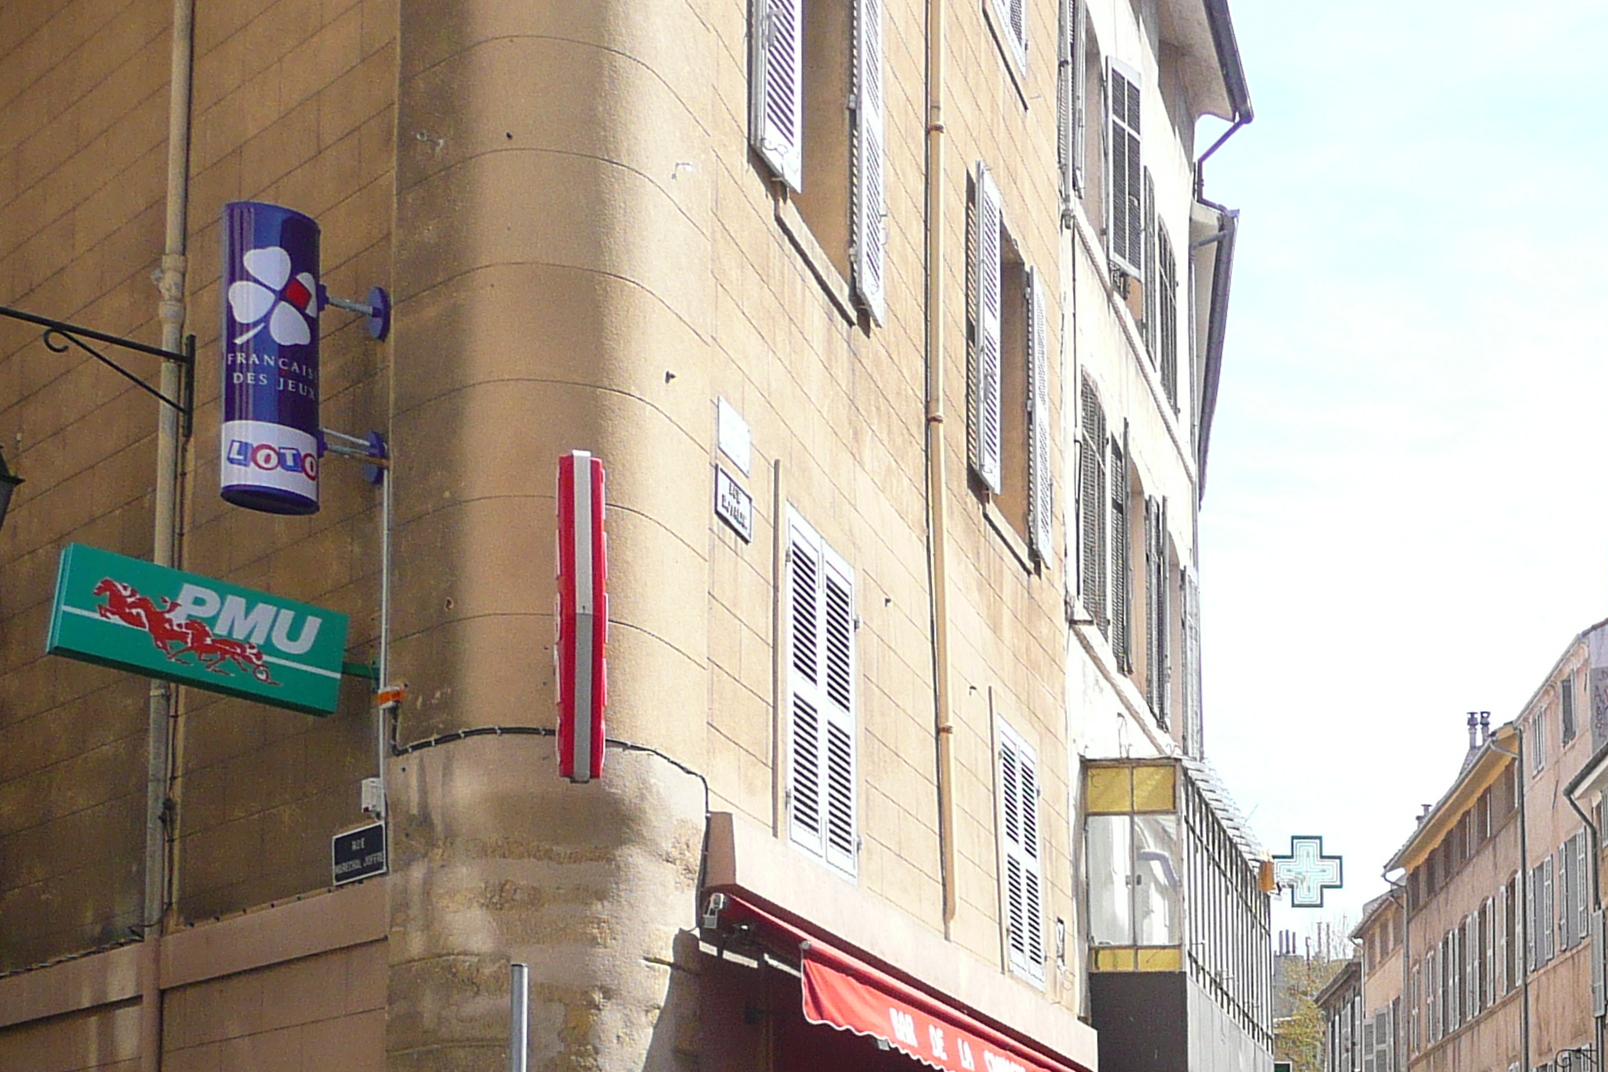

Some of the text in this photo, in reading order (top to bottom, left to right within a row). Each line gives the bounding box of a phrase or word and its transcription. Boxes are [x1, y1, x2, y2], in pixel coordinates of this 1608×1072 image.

[233, 372, 315, 400] DES JEUX
[227, 439, 317, 482] LOTO
[172, 583, 323, 655] PMU
